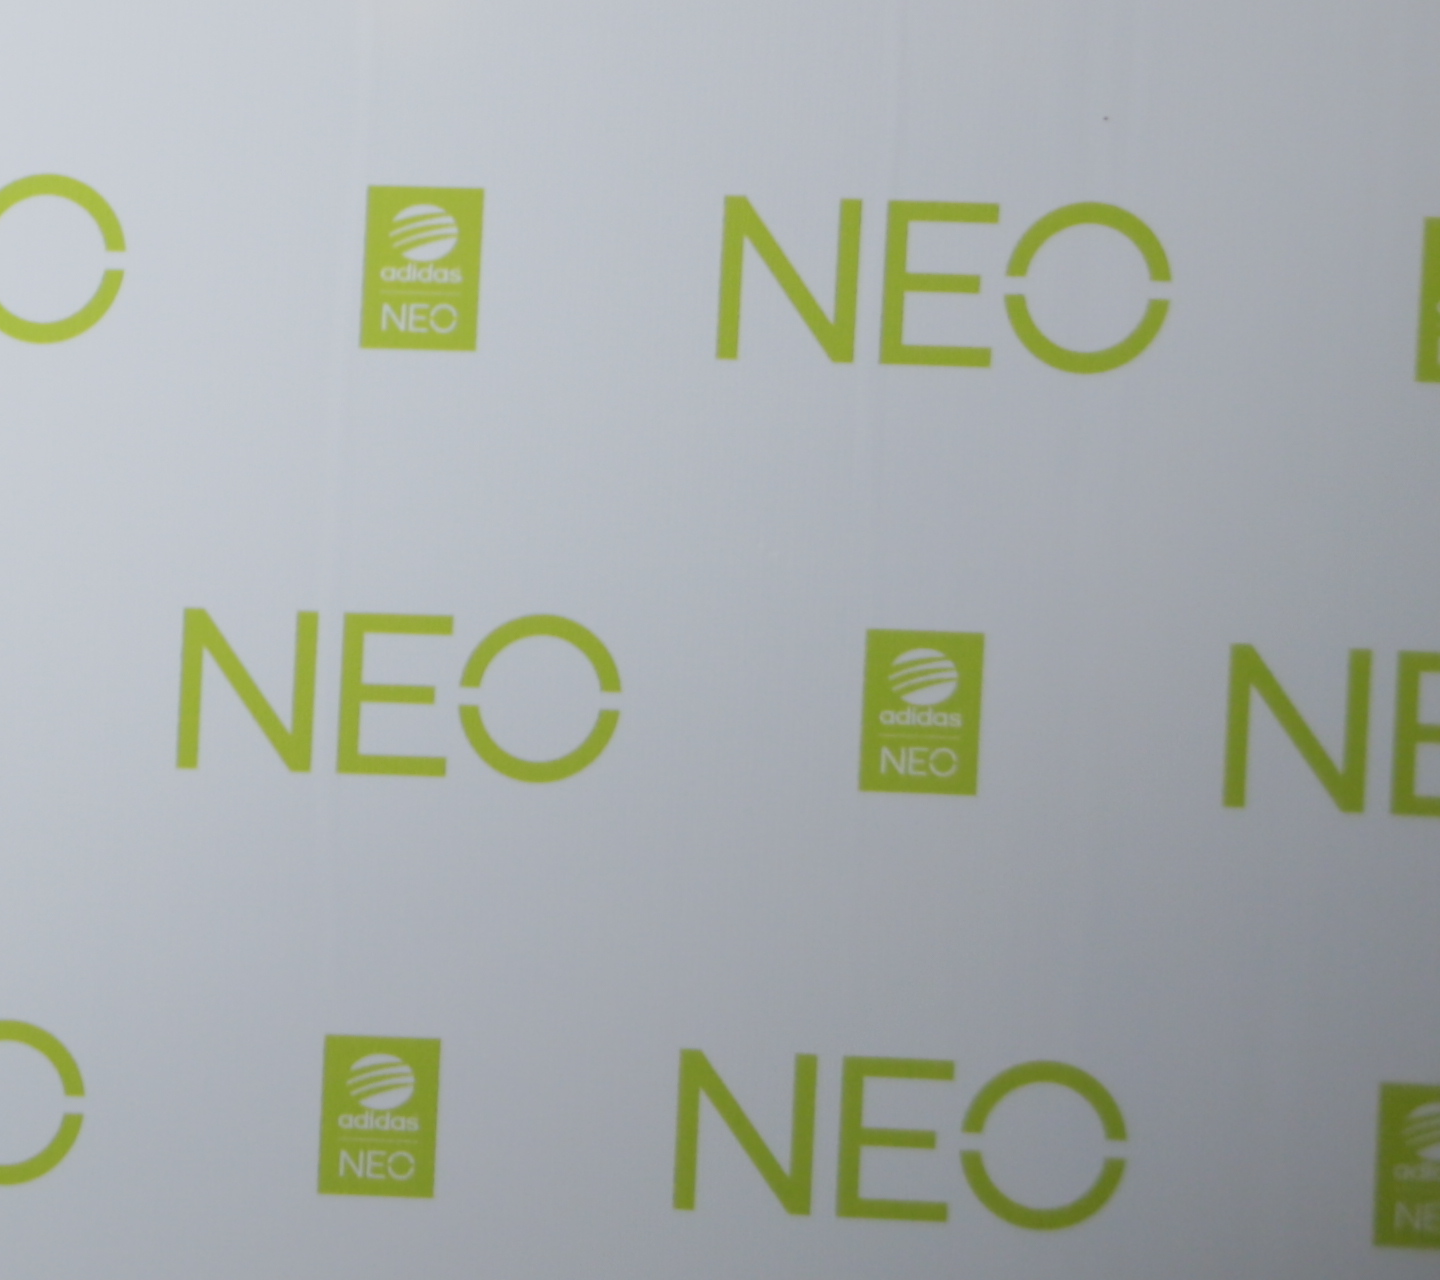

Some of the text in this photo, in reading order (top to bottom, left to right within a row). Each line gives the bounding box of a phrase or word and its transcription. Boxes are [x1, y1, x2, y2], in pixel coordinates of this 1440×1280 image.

[380, 262, 463, 283] adidas
[718, 196, 1172, 375] NEO
[381, 301, 460, 333] NEO
[178, 608, 621, 783] NEO
[879, 704, 963, 727] adidas
[1223, 643, 1440, 818] NE
[879, 743, 959, 778] NEO
[337, 1109, 420, 1131] adidas
[675, 1049, 1127, 1231] NEO
[338, 1147, 417, 1181] NEO
[1393, 1200, 1440, 1232] NE
